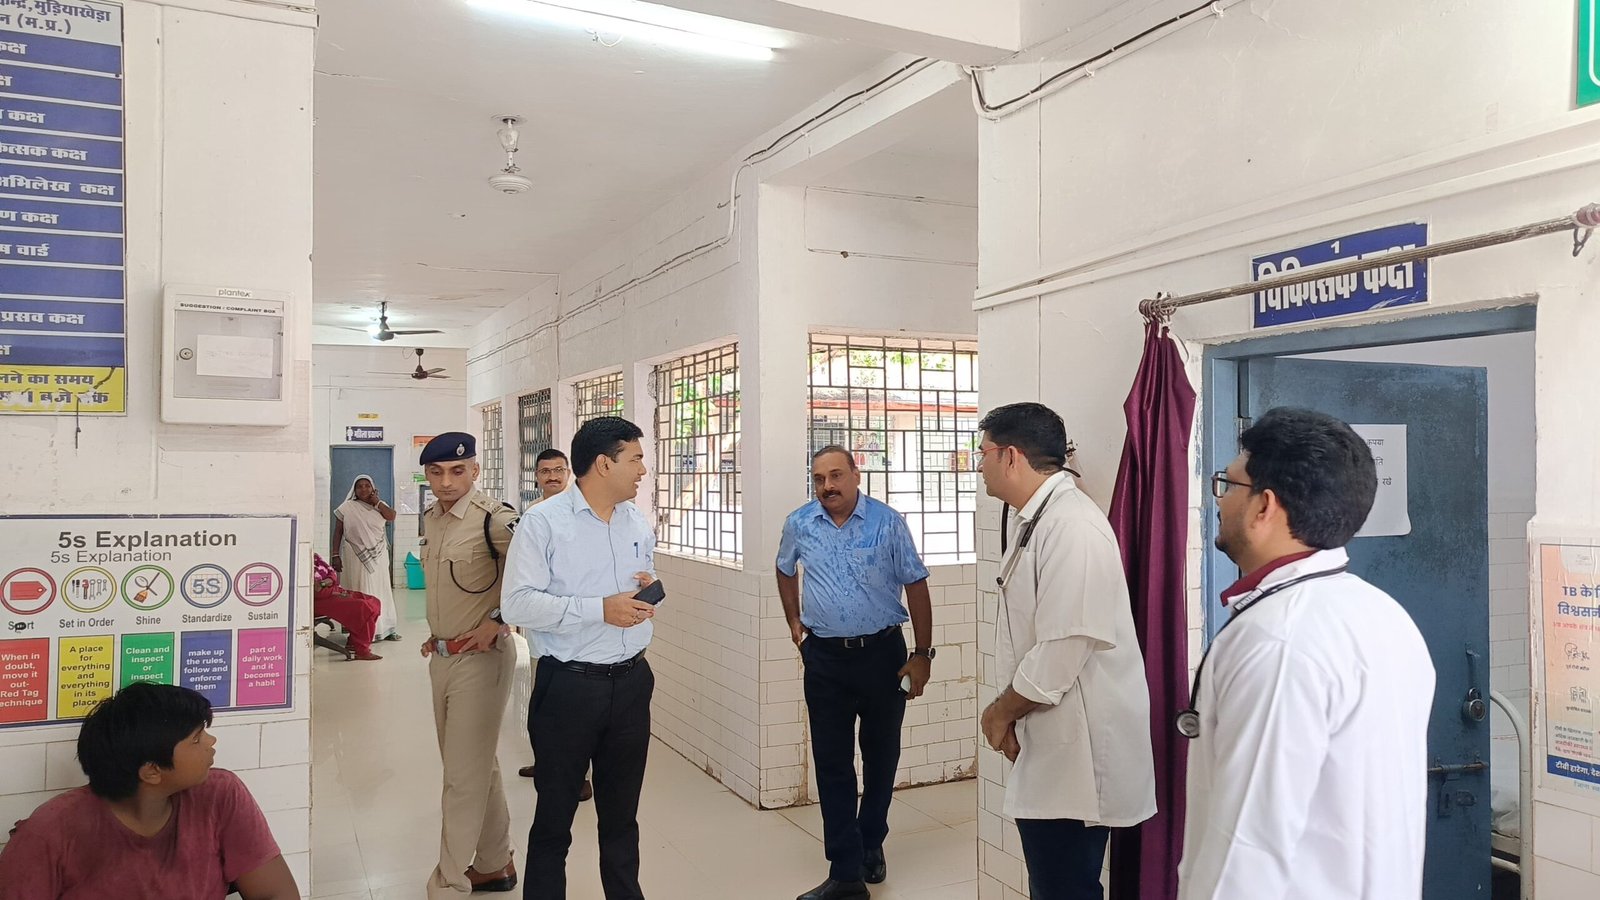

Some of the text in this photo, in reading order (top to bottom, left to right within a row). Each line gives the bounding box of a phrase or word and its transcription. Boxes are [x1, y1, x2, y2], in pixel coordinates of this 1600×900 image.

[7, 109, 46, 124] कक्ष
[50, 147, 88, 161] कक्ष
[80, 183, 116, 196] कक्ष
[21, 211, 59, 225] कक्ष
[16, 243, 50, 257] वार्ड
[1330, 240, 1341, 255] 1
[180, 302, 222, 310] SUGGESTION
[0, 311, 86, 325] प्रसव कक्ष
[27, 374, 50, 385] का
[54, 374, 95, 385] समय
[57, 529, 237, 551] 5s Explanation
[50, 550, 172, 565] 5s Explanation
[192, 577, 222, 595] 5S
[1562, 586, 1577, 597] TB
[1580, 584, 1592, 597] के
[135, 615, 162, 625] Shine
[182, 612, 233, 624] Standardize
[247, 610, 279, 621] Sustain
[8, 621, 34, 631] Srt
[59, 617, 115, 629] Set in Order
[78, 645, 104, 654] place
[125, 645, 170, 655] Clean and
[188, 649, 212, 657] make
[249, 647, 266, 655] part
[1, 652, 40, 661] When in
[79, 654, 93, 662] for
[131, 655, 164, 664] inspect
[242, 655, 262, 663] daily
[186, 657, 226, 666] the rules,
[4, 662, 36, 671] doubt,
[61, 663, 111, 672] everything
[2, 672, 29, 680] move
[76, 672, 95, 680] and
[130, 673, 164, 681] inspect
[189, 675, 222, 683] enforce
[10, 680, 30, 689] out-
[60, 681, 110, 690] everything
[195, 683, 217, 691] them
[0, 689, 39, 698] Red Tag
[85, 689, 97, 697] its
